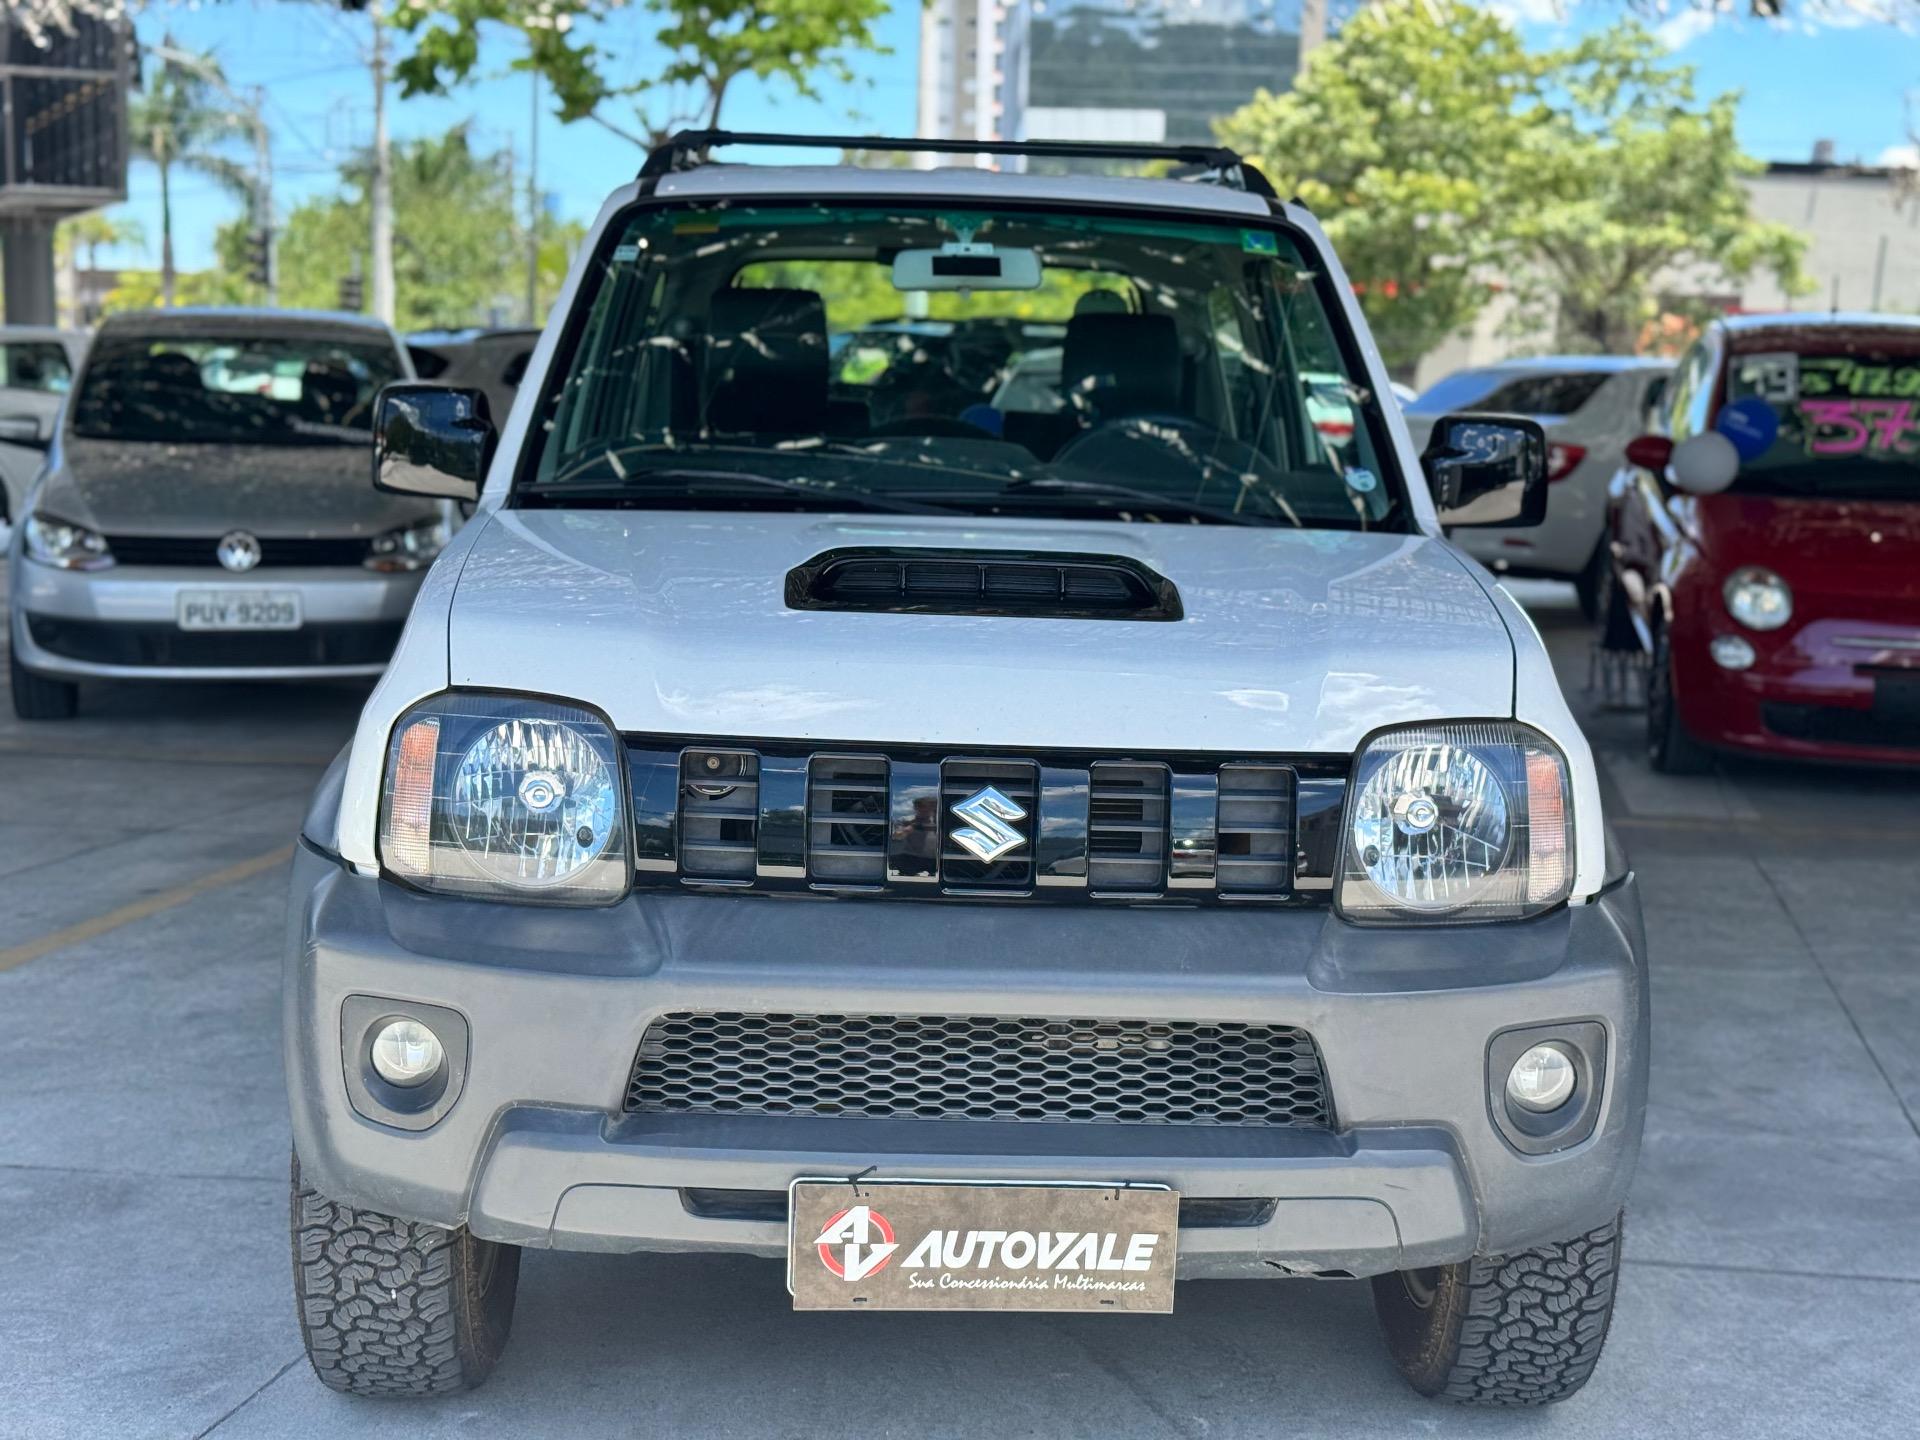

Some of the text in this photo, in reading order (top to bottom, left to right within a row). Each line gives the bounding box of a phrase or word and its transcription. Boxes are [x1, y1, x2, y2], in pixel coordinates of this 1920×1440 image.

[900, 1230, 1159, 1271] AUTOVALE
[909, 1272, 1147, 1291] Sua Concessionária Multimarcas
